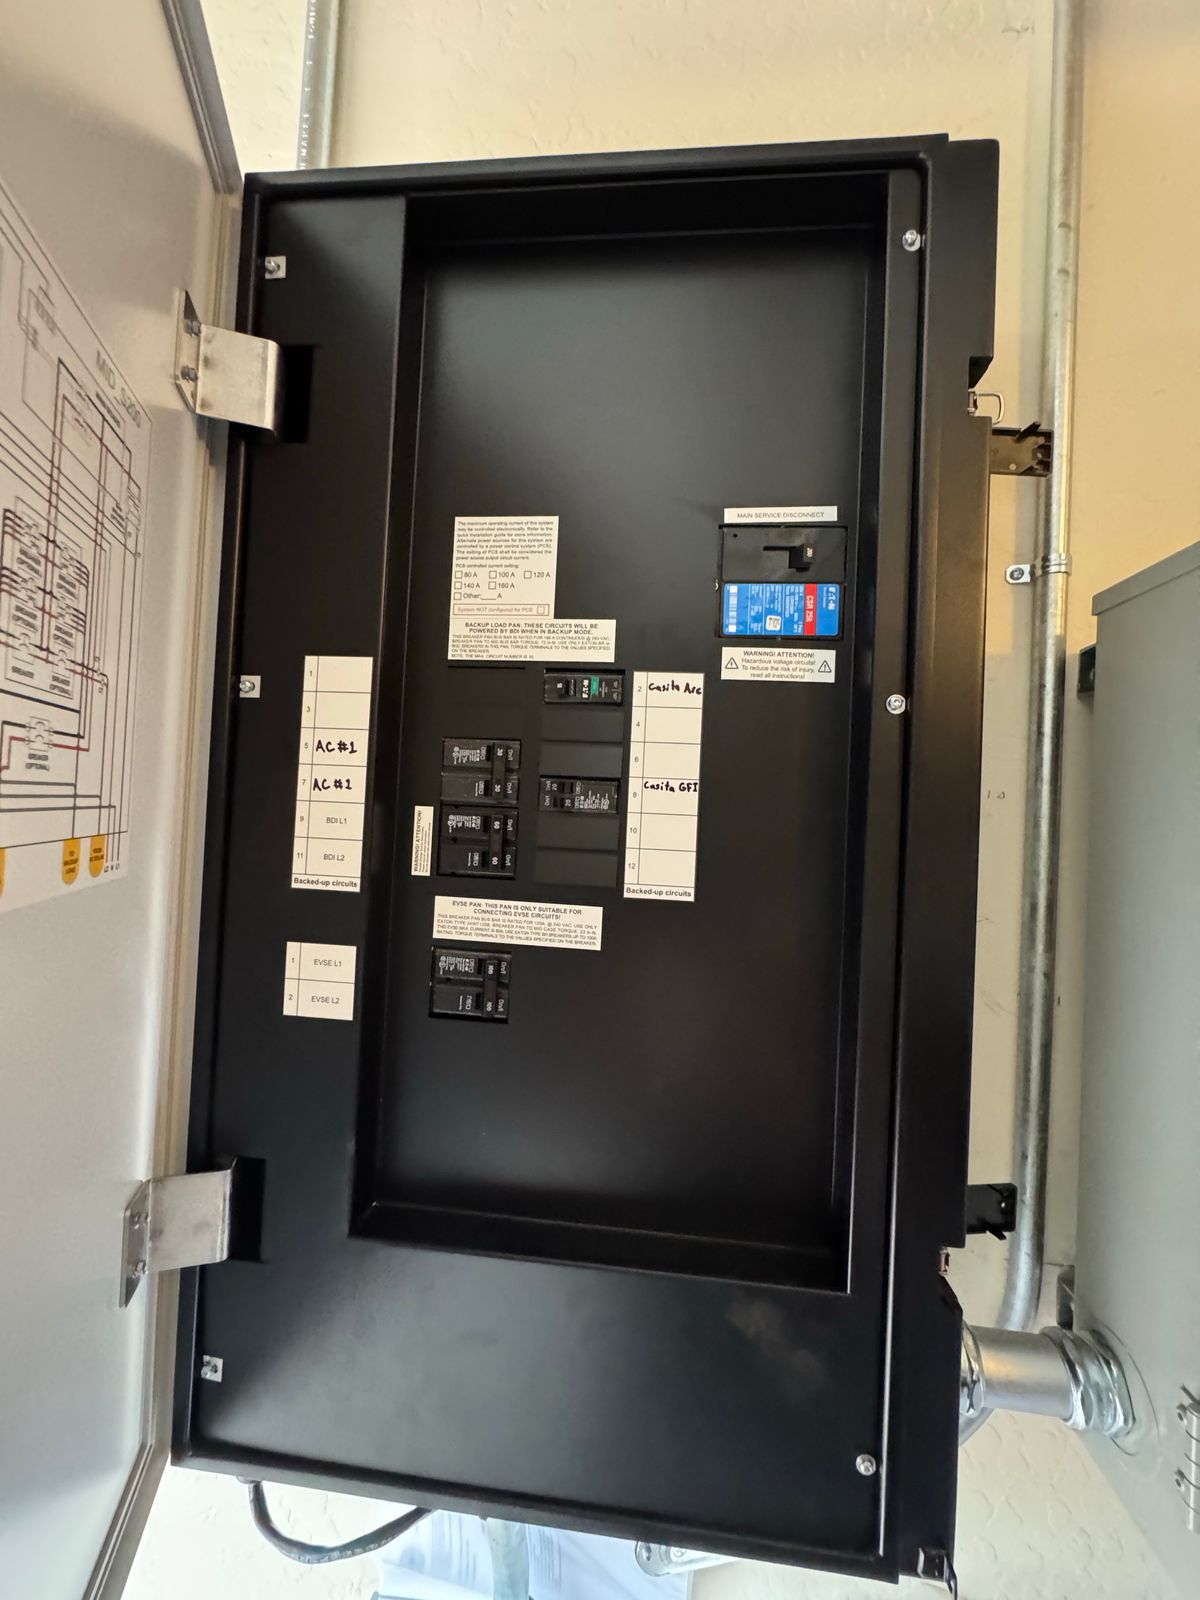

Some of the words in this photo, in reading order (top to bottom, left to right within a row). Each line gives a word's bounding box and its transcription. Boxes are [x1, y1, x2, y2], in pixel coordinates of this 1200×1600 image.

[649, 680, 680, 692] Casita
[684, 682, 702, 694] Arc
[316, 740, 335, 752] AC
[338, 740, 357, 754] #1
[497, 748, 503, 756] 30
[313, 778, 330, 791] AC
[495, 784, 501, 792] 30
[644, 781, 675, 792] Casita
[679, 783, 698, 792] GFI
[294, 878, 330, 887] Backed-up
[626, 887, 663, 896] Backed-up
[314, 958, 332, 967] EVSE
[311, 996, 329, 1004] EVSE
